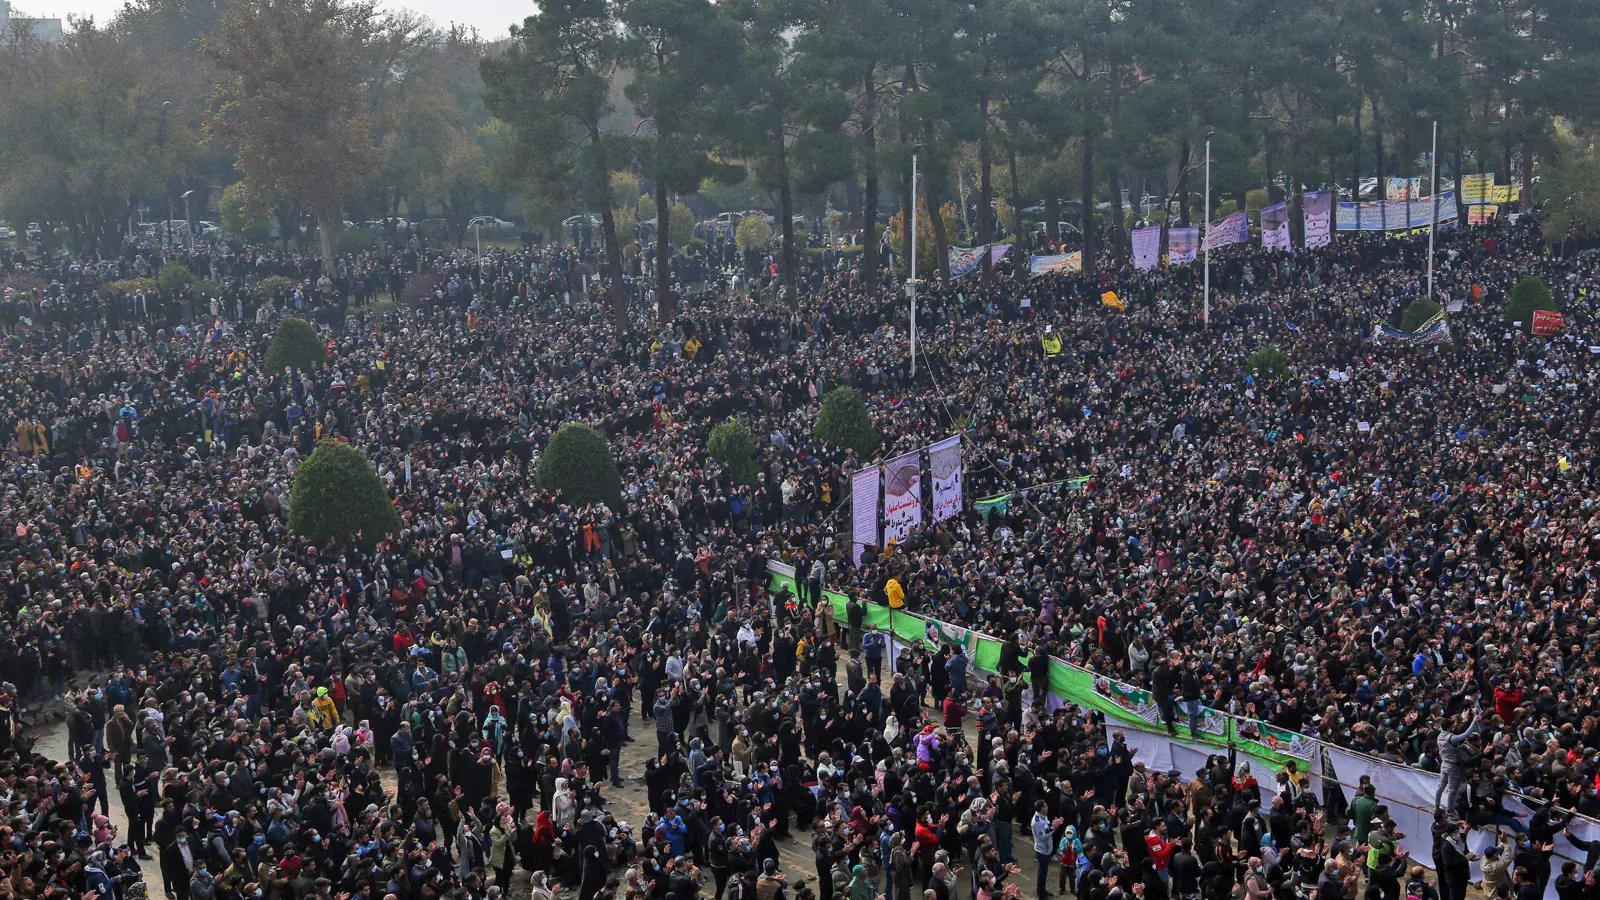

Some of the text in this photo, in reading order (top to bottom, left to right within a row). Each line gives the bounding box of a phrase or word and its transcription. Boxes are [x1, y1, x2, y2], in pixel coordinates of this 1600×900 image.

[886, 501, 899, 517] اصفهان
[891, 515, 914, 530] یعنی سقوط
